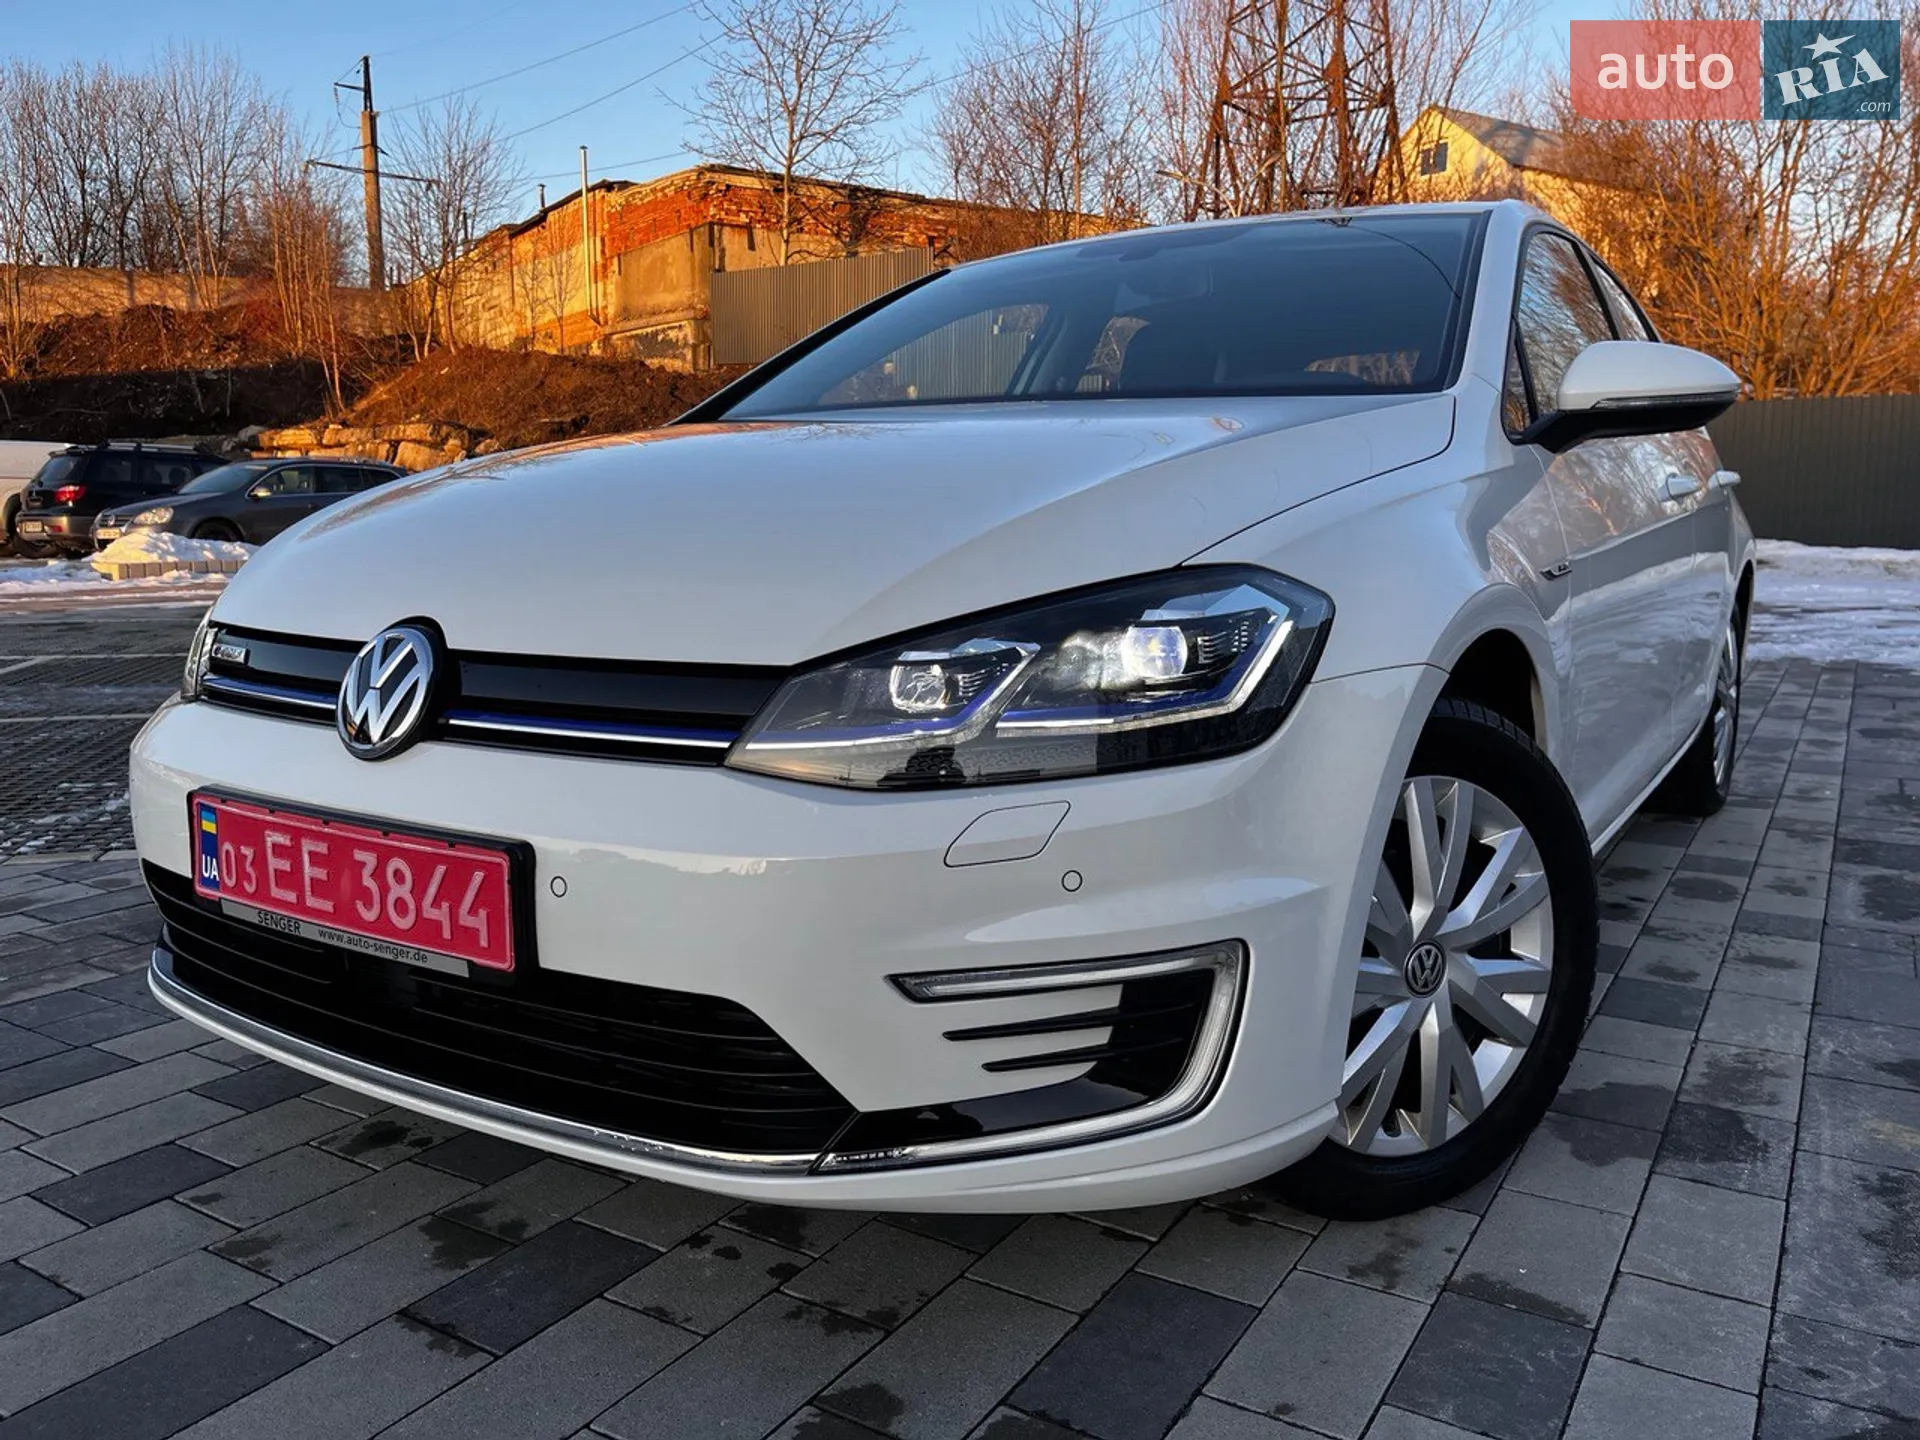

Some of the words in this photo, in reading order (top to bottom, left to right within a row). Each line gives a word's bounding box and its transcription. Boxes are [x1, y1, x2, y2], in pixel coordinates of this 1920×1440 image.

[202, 853, 219, 881] UA
[222, 841, 257, 894] 03
[264, 830, 335, 913] EE
[353, 849, 489, 948] 3844
[257, 911, 301, 935] SENGER
[318, 928, 428, 963] www.auto-senger.de
